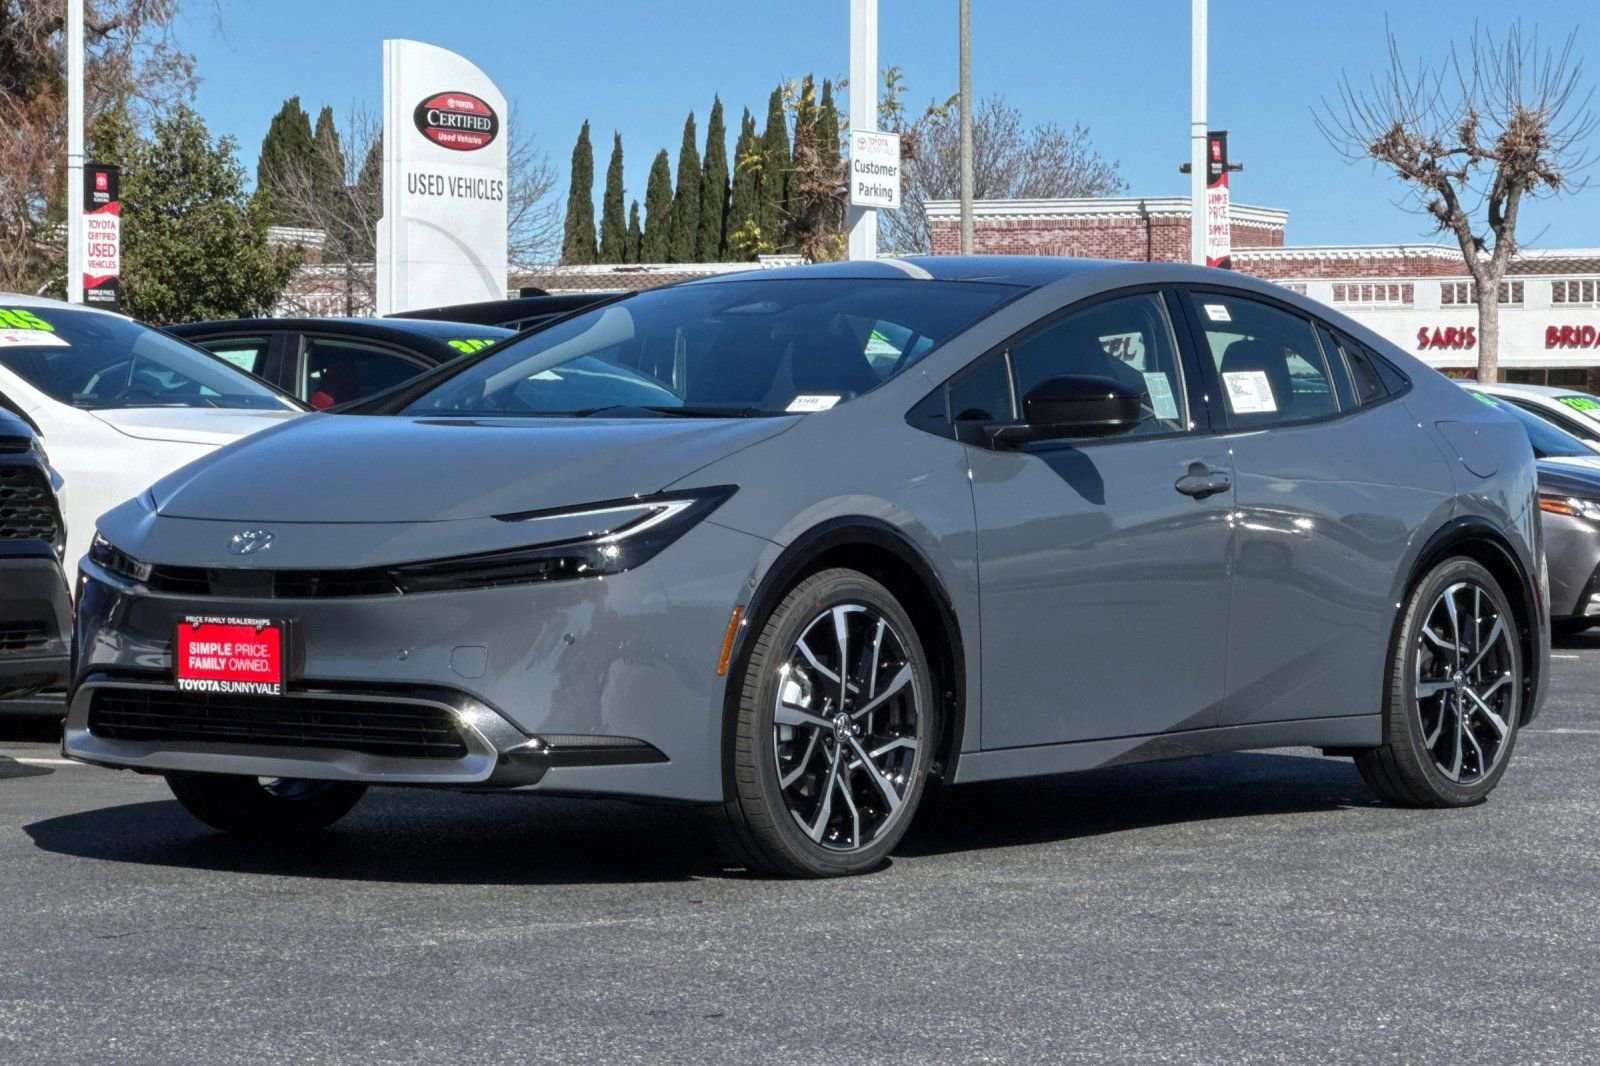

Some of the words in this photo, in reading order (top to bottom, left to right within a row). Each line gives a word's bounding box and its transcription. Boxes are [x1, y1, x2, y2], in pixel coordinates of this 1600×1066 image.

[427, 109, 491, 131] CERTIFIED
[438, 132, 457, 142] Used
[457, 133, 482, 145] Vehicles
[854, 159, 897, 177] Customer
[407, 172, 445, 196] USED
[448, 176, 504, 202] VEHICLES
[858, 182, 893, 202] Parking
[88, 219, 116, 230] TOYOTA
[87, 232, 117, 241] CERTIFIED
[87, 243, 116, 258] USED
[88, 260, 117, 270] VEHICLES
[1416, 326, 1477, 350] SARIS
[185, 615, 204, 624] PRICE
[204, 616, 226, 625] FAMILY
[227, 617, 271, 627] DEALERSHIPS
[189, 641, 232, 657] SIMPLE
[235, 643, 271, 658] PRICE.
[188, 656, 227, 670] FAMILY
[228, 658, 271, 673] OWNED.
[178, 678, 220, 692] TOYOTA
[220, 680, 281, 695] SUNNYVALE
